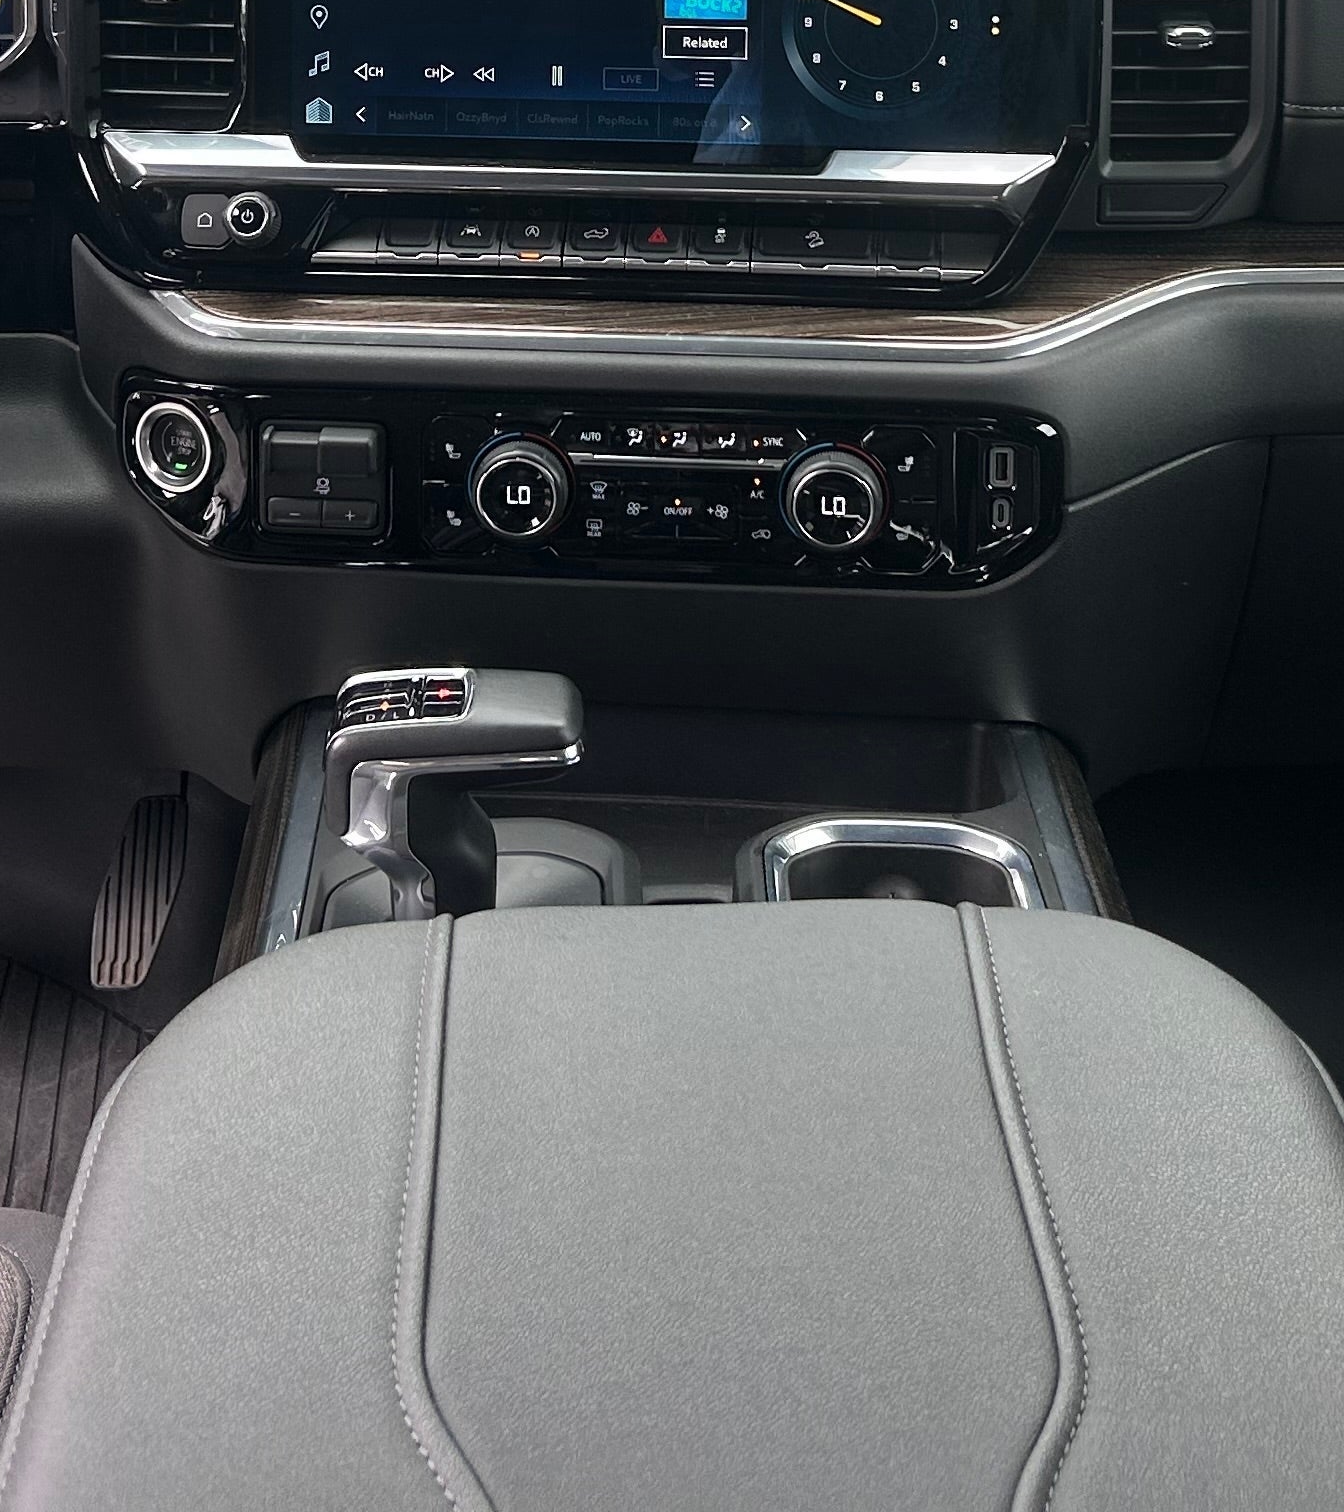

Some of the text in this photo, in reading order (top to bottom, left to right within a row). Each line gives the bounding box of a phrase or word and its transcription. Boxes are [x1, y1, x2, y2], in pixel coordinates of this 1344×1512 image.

[804, 17, 813, 27] 9
[949, 19, 958, 30] 3
[682, 36, 728, 49] Related
[812, 53, 821, 63] 8
[938, 56, 947, 66] 4
[368, 67, 384, 77] CH
[424, 68, 441, 78] CH
[620, 75, 642, 85] LIVE
[838, 80, 847, 90] 7
[912, 82, 920, 92] 5
[875, 91, 884, 101] 6
[388, 110, 435, 121] HairNatn
[456, 112, 507, 125] OzzyBnyd
[598, 115, 649, 128] PopRocks
[580, 432, 602, 442] AUTO
[762, 437, 784, 447] SYNC
[506, 485, 530, 505] LO
[750, 490, 764, 500] A/C
[664, 506, 693, 516] ON/OFF
[821, 496, 847, 516] LO
[365, 713, 376, 722] D
